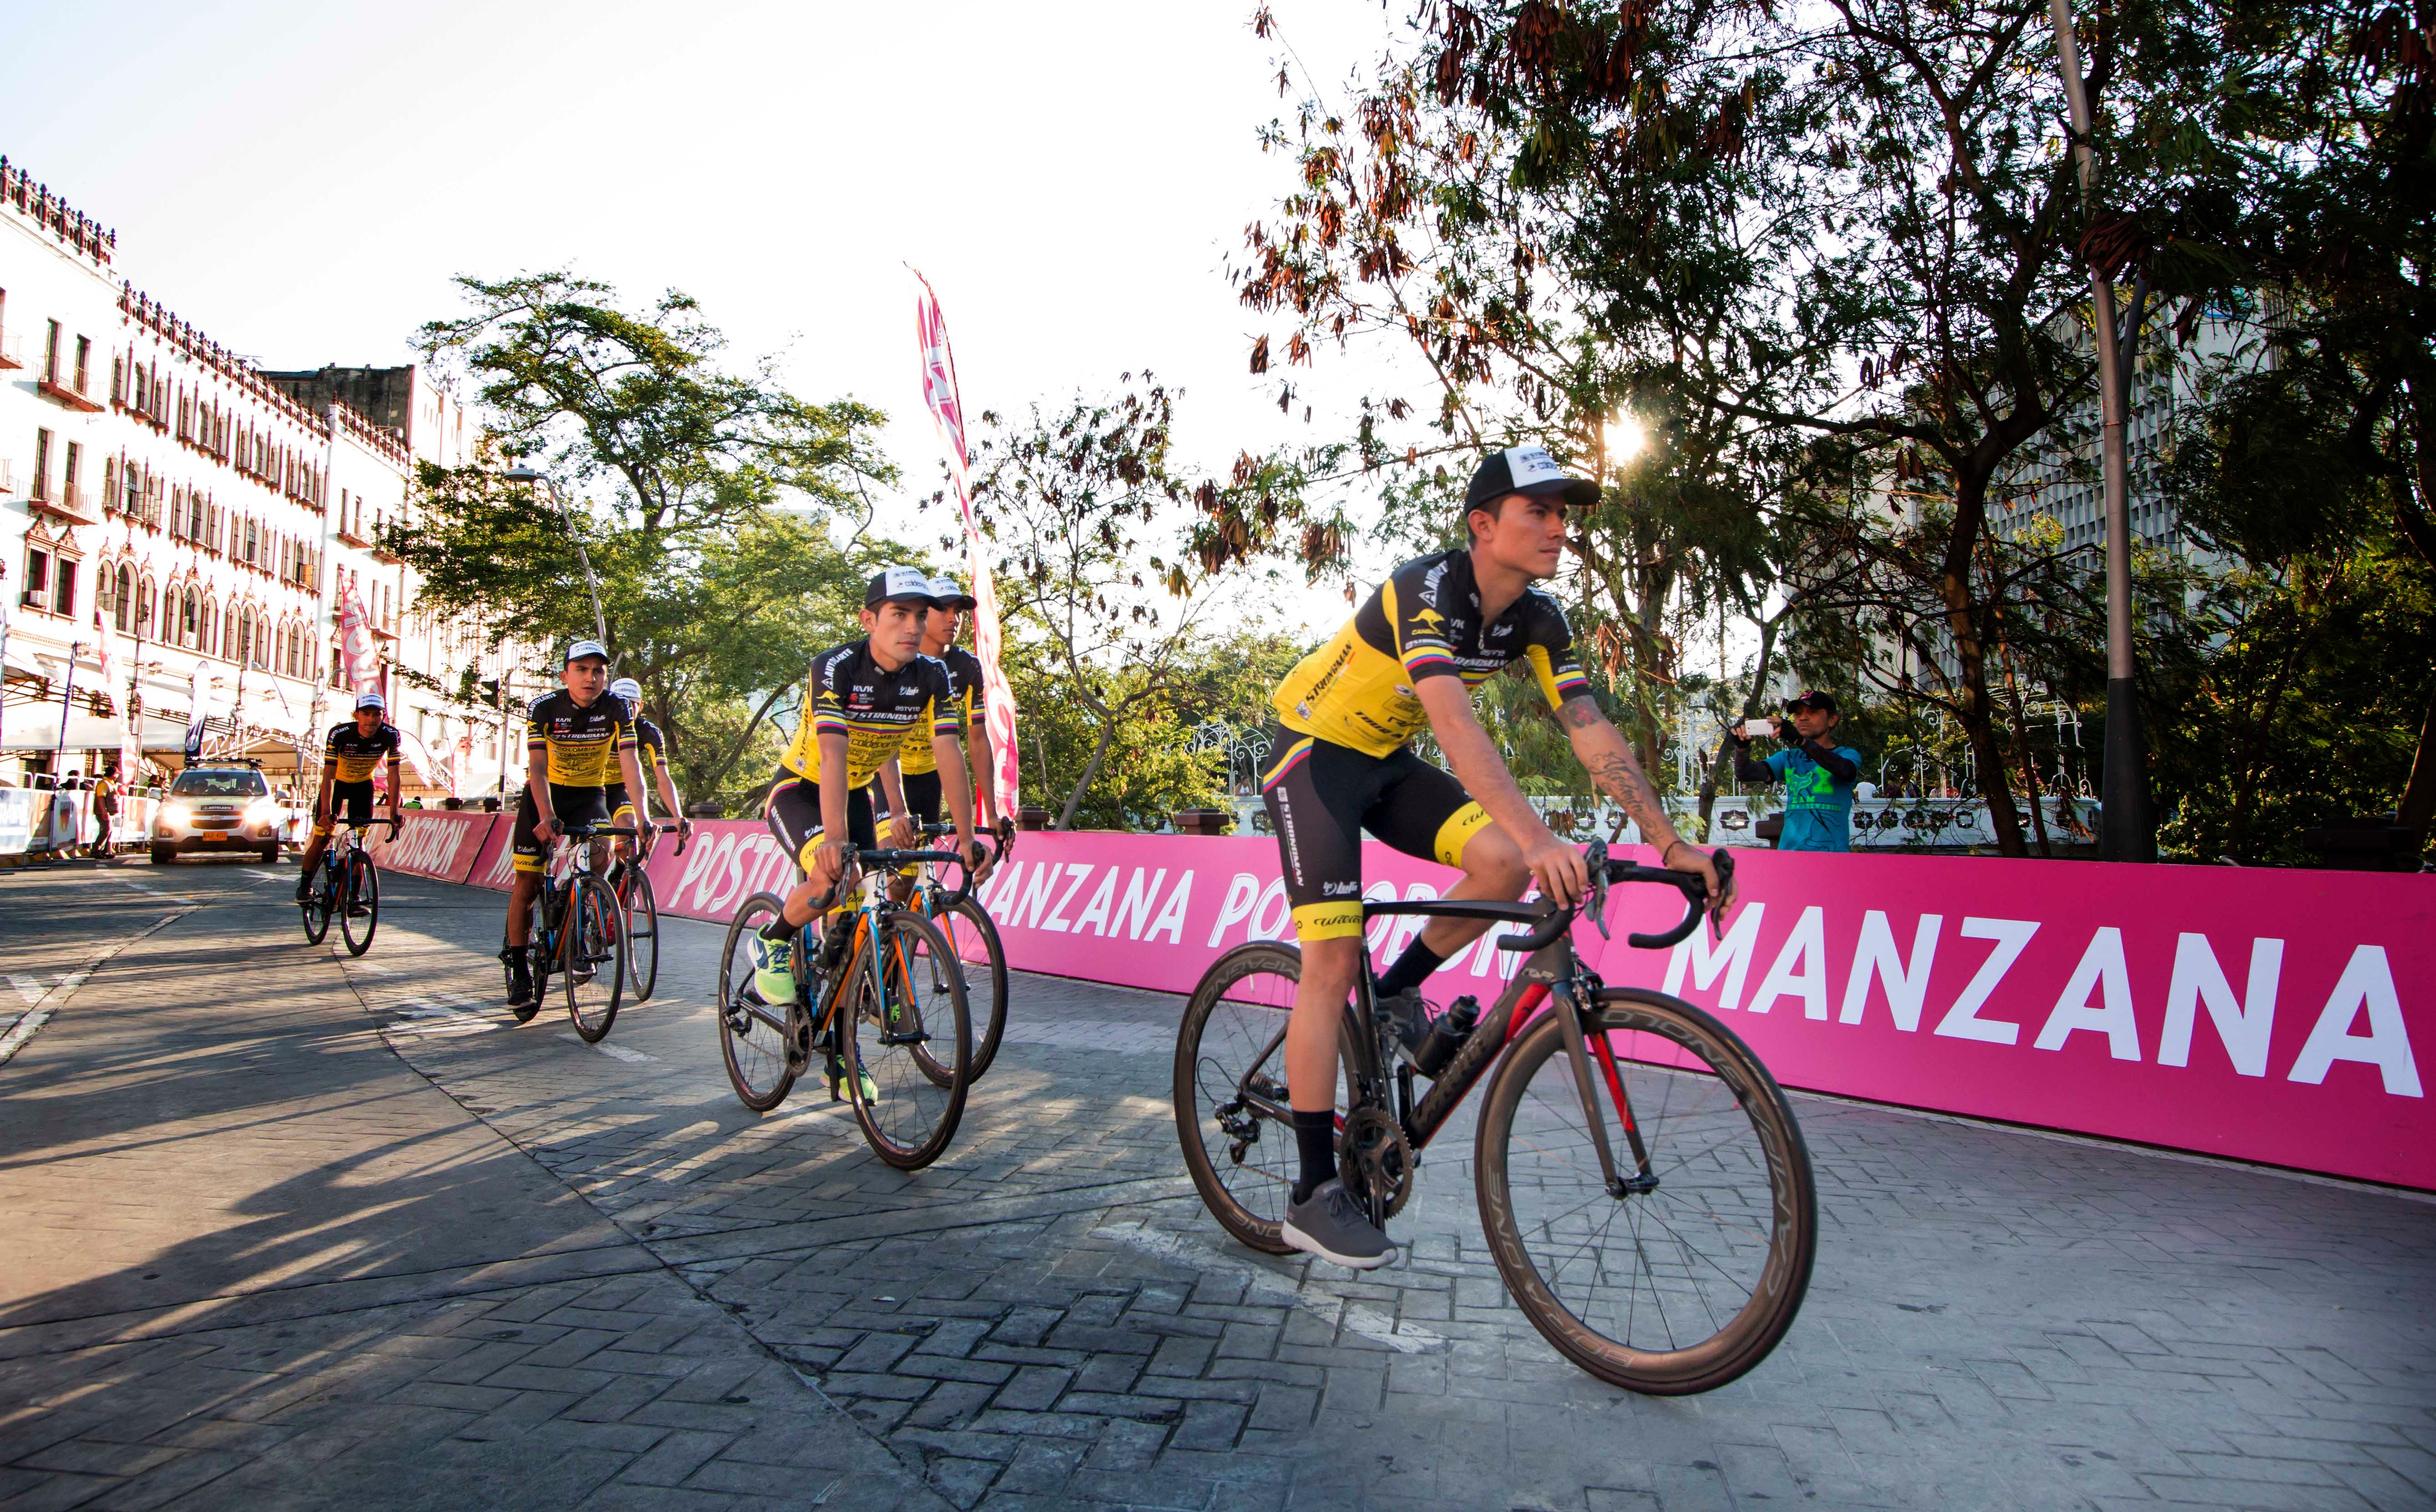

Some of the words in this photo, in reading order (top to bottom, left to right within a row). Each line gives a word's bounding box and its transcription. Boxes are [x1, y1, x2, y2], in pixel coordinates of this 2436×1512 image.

[848, 730, 901, 740] COLOMBIA
[859, 711, 918, 720] STRONGMA
[668, 832, 797, 925] POSTO
[1661, 901, 2424, 1098] MANZANA
